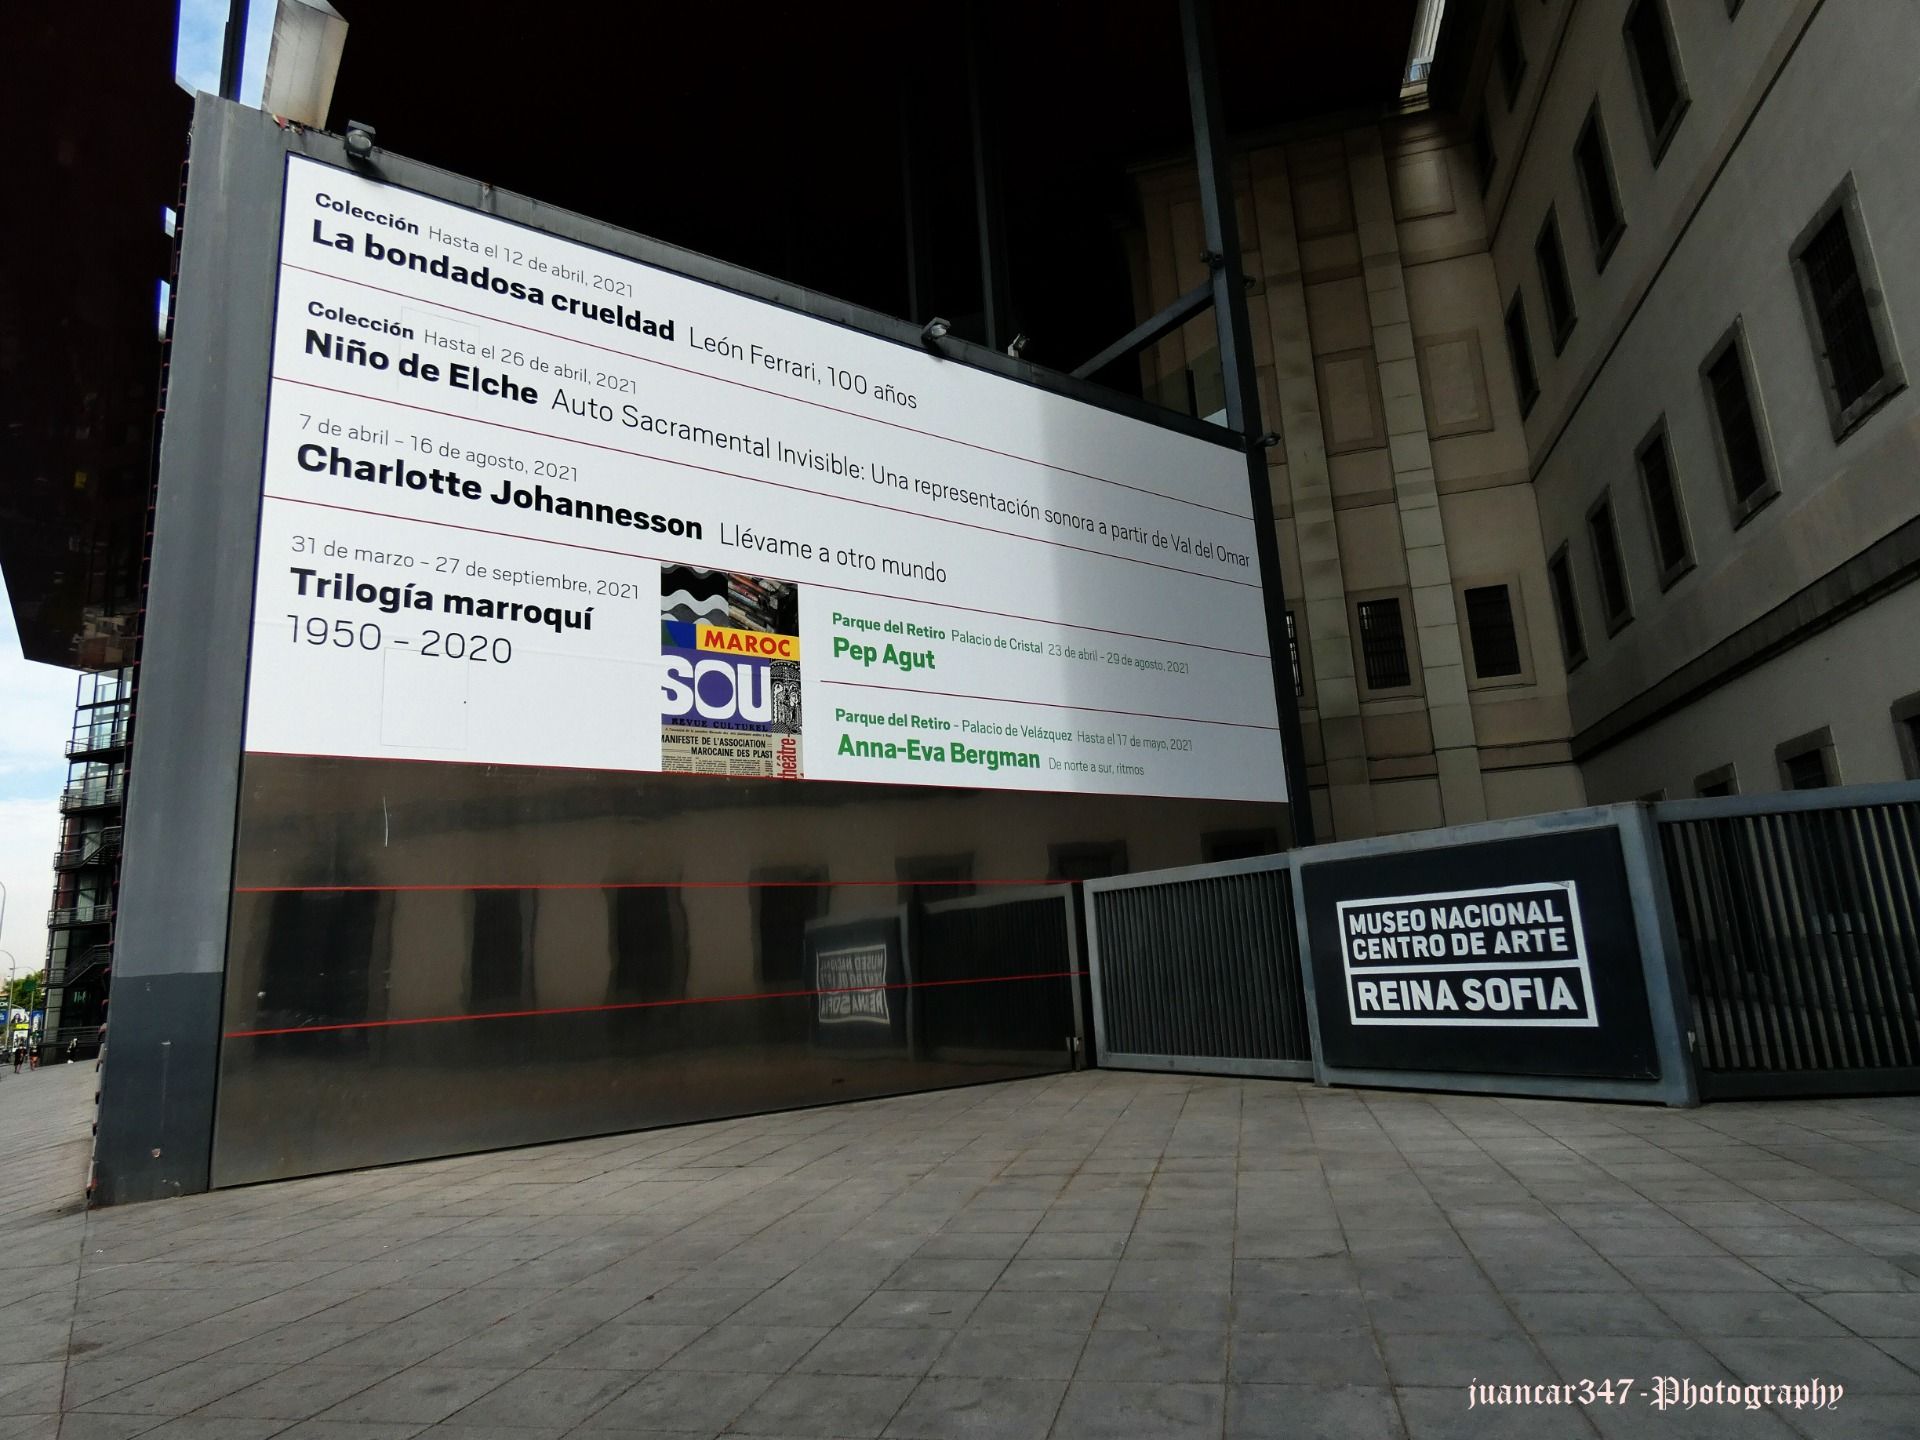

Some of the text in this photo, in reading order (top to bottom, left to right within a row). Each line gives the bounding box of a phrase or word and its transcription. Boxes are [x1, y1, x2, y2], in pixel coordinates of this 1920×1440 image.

[315, 193, 633, 298] Colección Hasta el 12 de abril, 2021
[312, 220, 918, 409] La bondadosa crueldad León Ferrari, 100 años
[308, 301, 637, 395] Colección Hasta el 26 de abril, 2021
[299, 414, 311, 430] 7
[318, 418, 342, 436] de
[348, 425, 389, 446] abril
[410, 435, 432, 454] 16
[438, 441, 460, 459] de
[465, 449, 528, 474] agosto,
[534, 461, 578, 482] 2021
[305, 328, 1250, 568] Niño de Elche Auto Sacramental Invisible: Una representación sonora a partir de Val del Omar
[297, 443, 947, 583] Charlotte Johannesson Llévame a otro mundo
[291, 535, 315, 554] 31
[323, 539, 348, 558] de
[355, 547, 415, 568] marzo
[436, 557, 459, 574] 27
[465, 560, 487, 579] de
[492, 566, 591, 595] septiembre,
[596, 579, 639, 600] 2021
[290, 567, 594, 633] Trilogía marroquí
[288, 614, 382, 652] 1950
[420, 630, 512, 664] 2020
[704, 630, 790, 657] MAROC
[832, 612, 881, 634] Parque
[883, 619, 904, 635] del
[906, 622, 945, 640] Retiro
[951, 629, 992, 648] Palacio
[994, 634, 1007, 649] de
[1009, 636, 1043, 654] Cristal
[1048, 643, 1062, 657] 23
[1064, 645, 1076, 659] de
[1078, 647, 1098, 662] abril
[1107, 651, 1120, 665] 29
[1121, 653, 1132, 667] de
[1134, 658, 1165, 673] agosto,
[1167, 659, 1189, 674] 2021
[833, 636, 936, 672] Pep Agut
[661, 654, 772, 723] SOU
[671, 718, 769, 732] REVUE CULTUREL
[702, 737, 711, 745] DE
[714, 738, 766, 748] L'ASSOCIATION
[835, 708, 885, 729] Parque
[888, 713, 908, 728] del
[911, 714, 951, 731] Retiro
[962, 720, 1002, 737] Palacio
[1005, 723, 1017, 738] de
[1020, 724, 1072, 744] Velázquez
[1077, 730, 1105, 745] Hasta
[1107, 732, 1116, 746] el
[1118, 733, 1128, 746] 17
[1130, 734, 1141, 748] de
[1142, 738, 1168, 752] mayo,
[1170, 737, 1193, 752] 2021
[691, 746, 733, 757] MAROCAINE
[737, 750, 750, 758] DES
[837, 734, 1145, 776] Anna-Eva Bergman De norte a sur, ritmos
[1349, 899, 1564, 935] MUSEO NACIONAL
[1352, 928, 1569, 960] CENTRO DE ARTE
[1357, 976, 1578, 1011] REINA SOFIA
